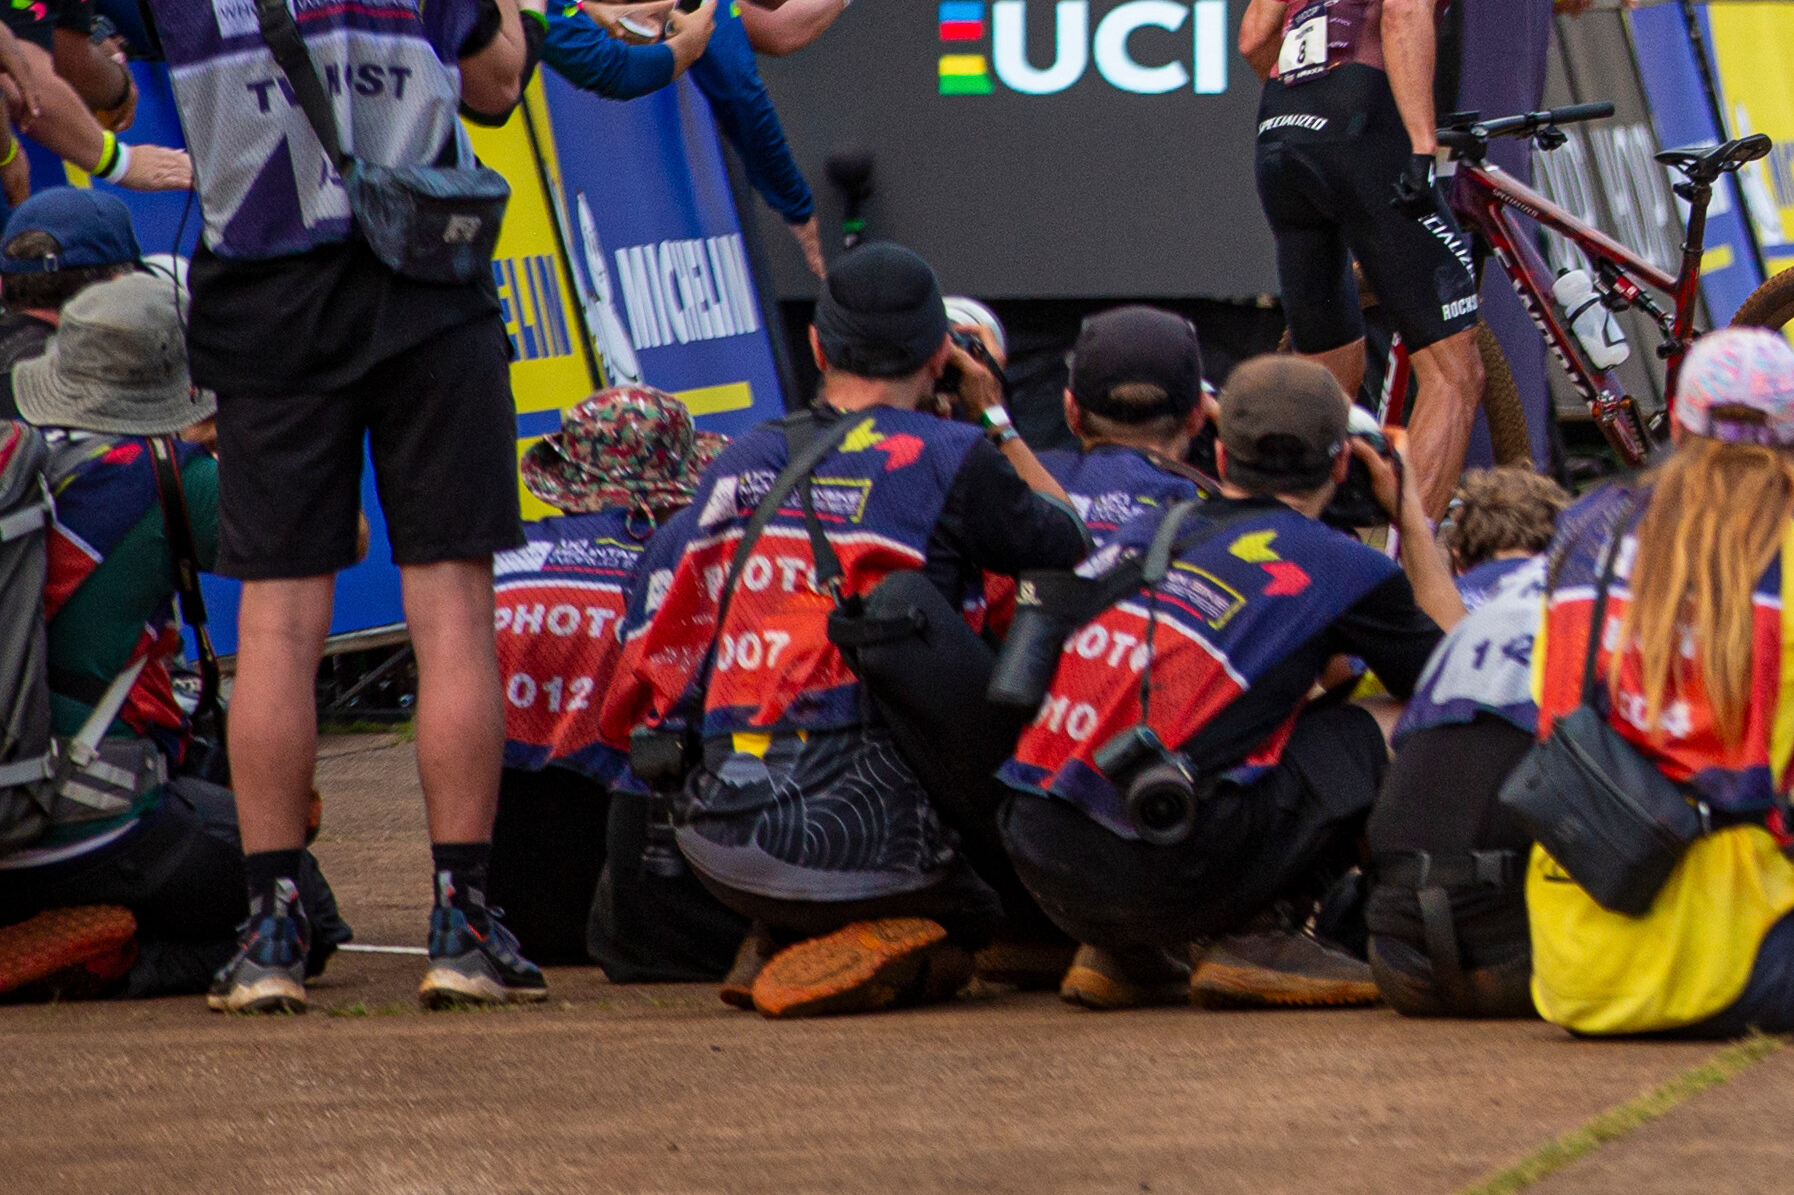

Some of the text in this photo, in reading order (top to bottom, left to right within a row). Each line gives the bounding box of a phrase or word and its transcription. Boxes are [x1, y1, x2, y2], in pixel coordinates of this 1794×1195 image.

[991, 0, 1229, 96] UCI
[1258, 114, 1329, 136] SPECIALIZED
[615, 232, 760, 351] MICHELIN
[506, 671, 595, 714] 012
